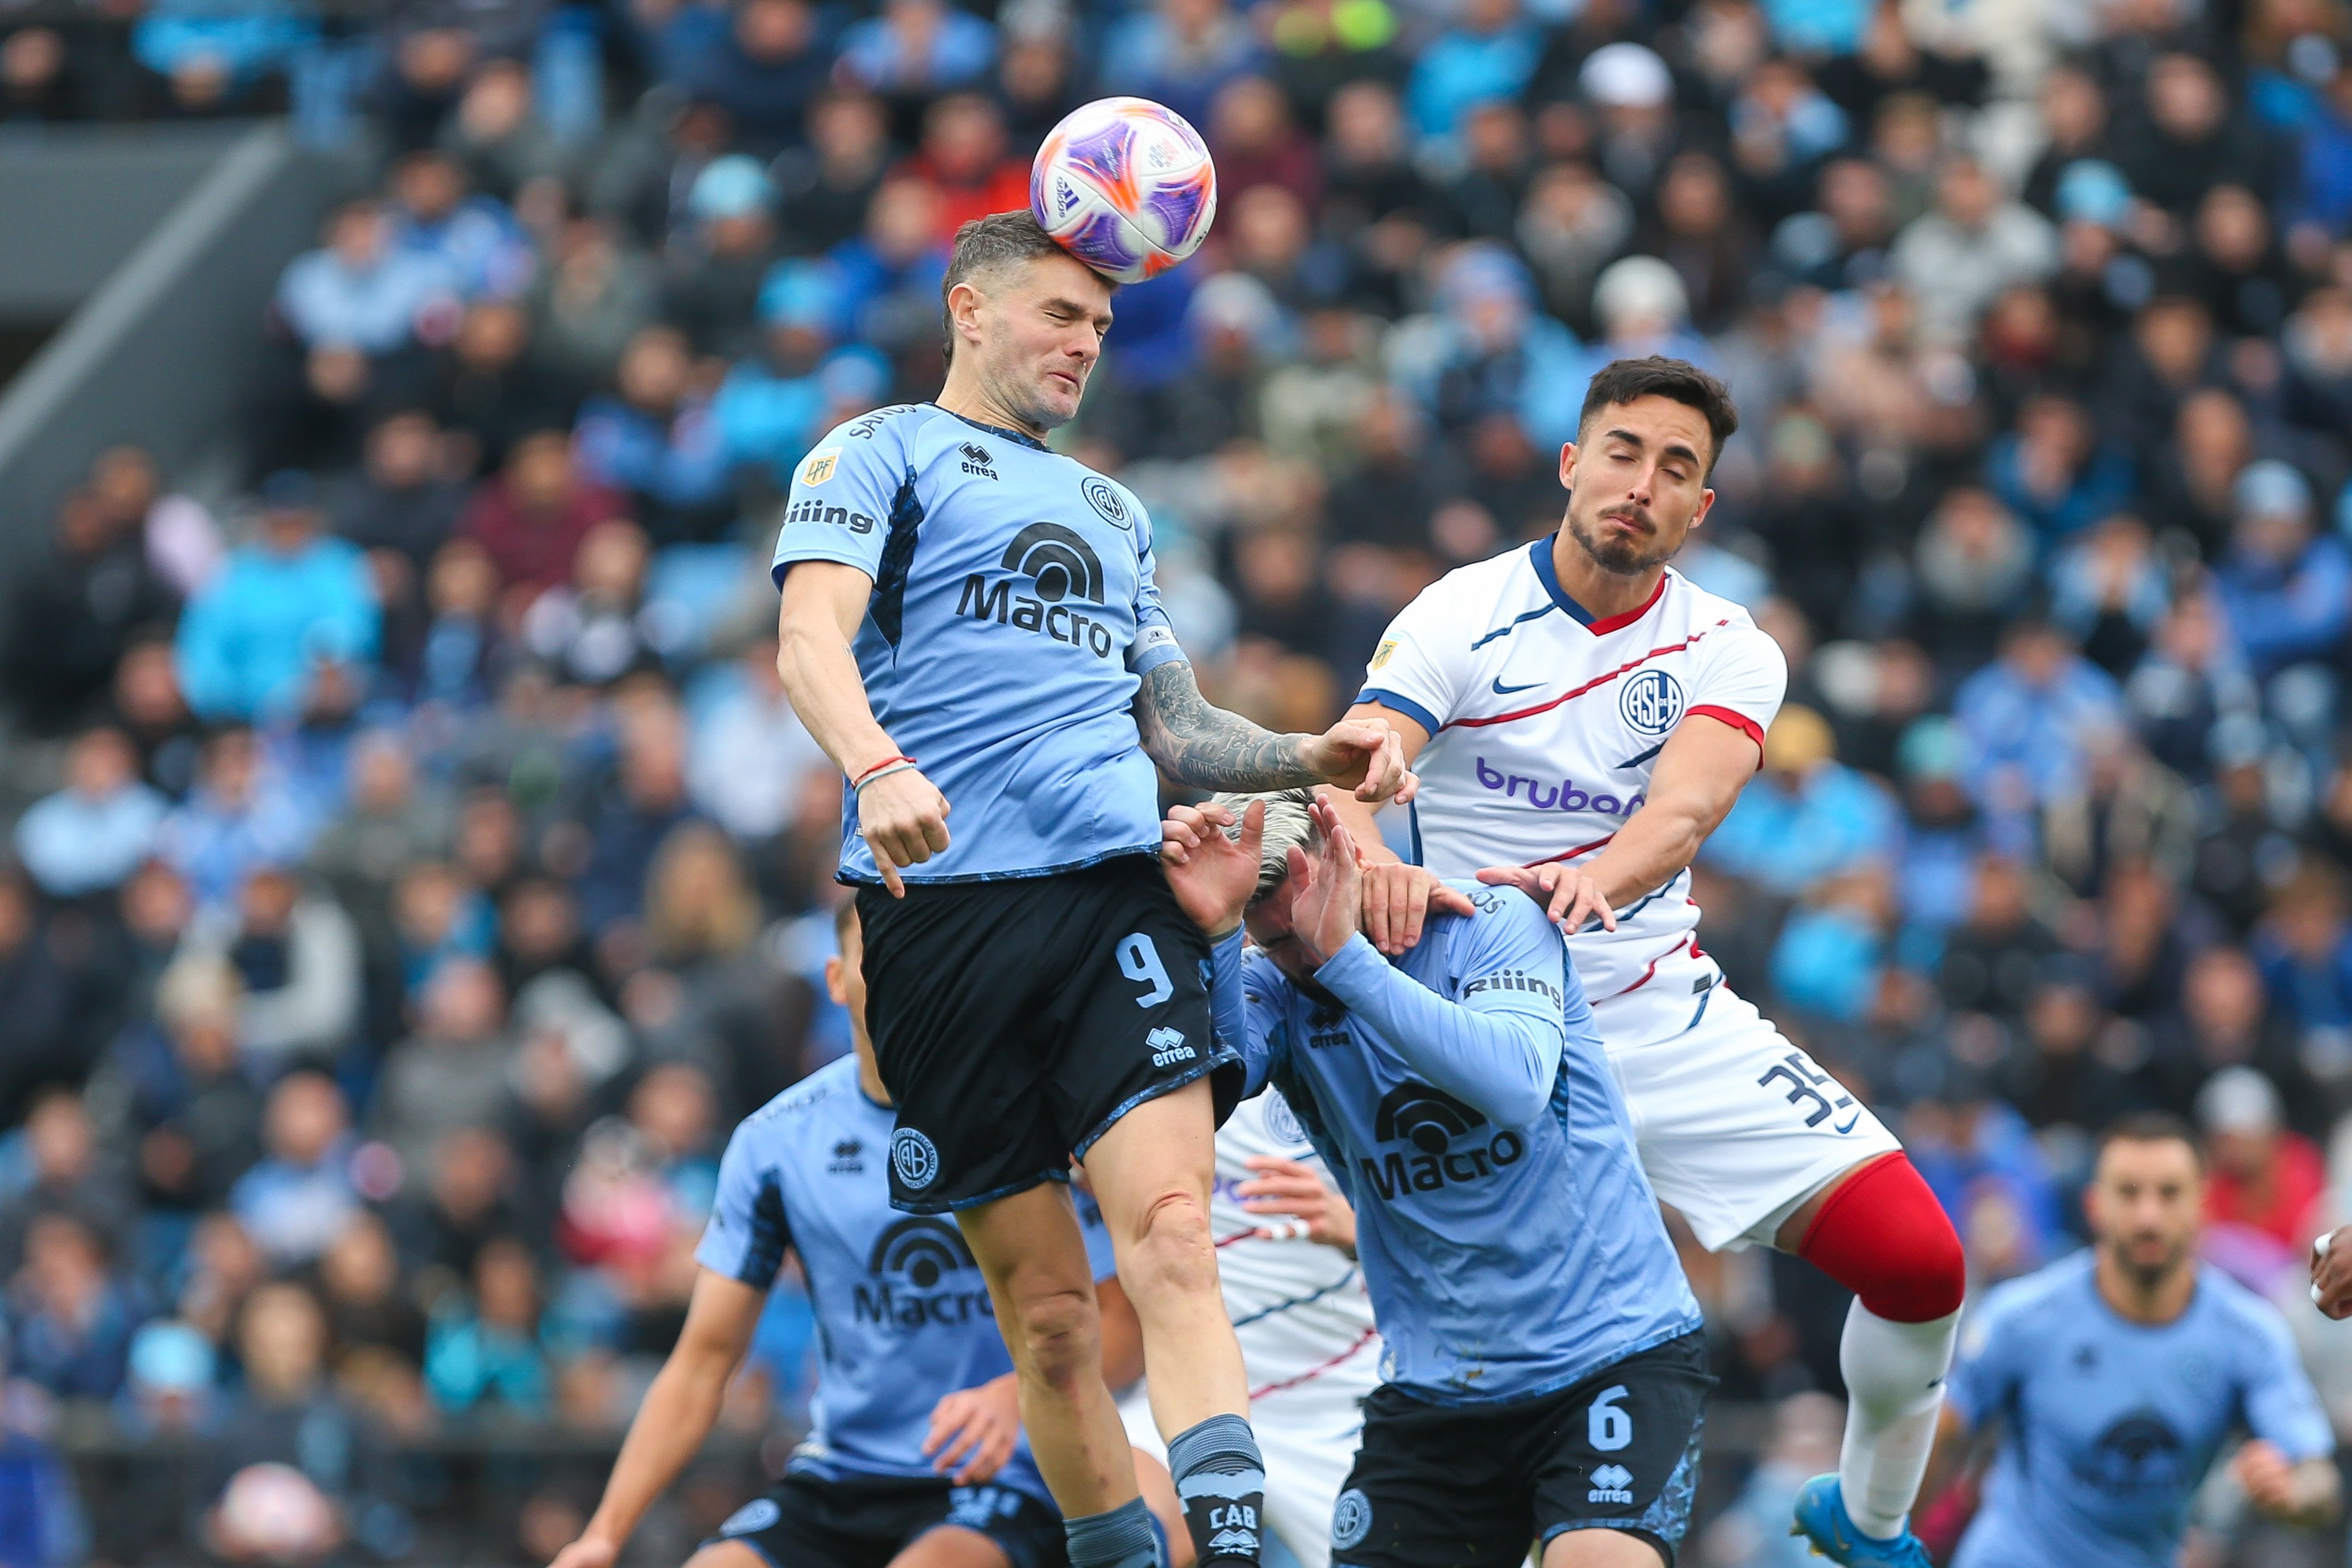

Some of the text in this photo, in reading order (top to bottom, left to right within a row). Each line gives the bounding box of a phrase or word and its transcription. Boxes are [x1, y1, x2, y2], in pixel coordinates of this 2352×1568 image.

[961, 462, 998, 481] errea
[784, 499, 873, 534] iiing
[956, 574, 1112, 657] Macro
[1116, 932, 1173, 1008] 9
[1463, 969, 1561, 1012] Riiing
[1152, 1046, 1196, 1067] errea
[1310, 1031, 1350, 1048] errea
[1360, 1130, 1521, 1199] Macro
[1588, 1385, 1633, 1451] 6
[1588, 1488, 1633, 1505] errea
[1209, 1504, 1258, 1529] CAB
